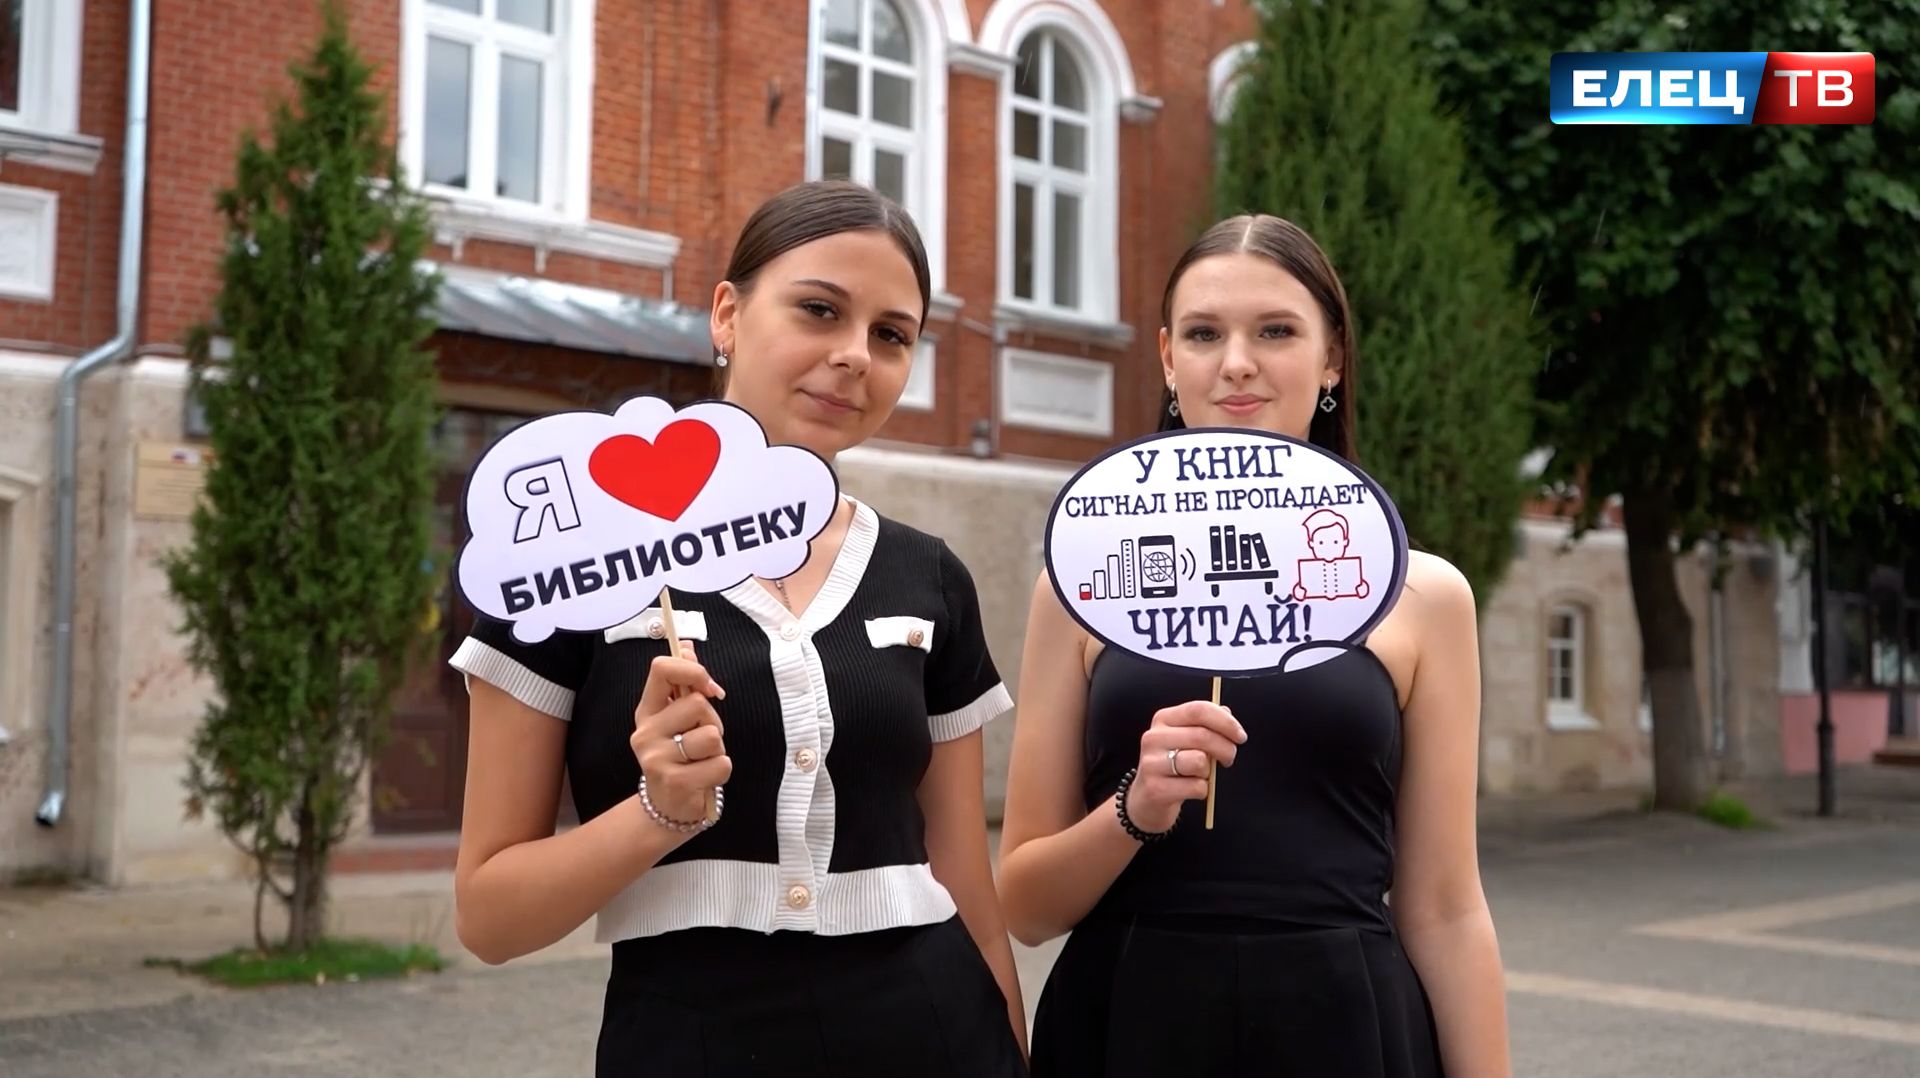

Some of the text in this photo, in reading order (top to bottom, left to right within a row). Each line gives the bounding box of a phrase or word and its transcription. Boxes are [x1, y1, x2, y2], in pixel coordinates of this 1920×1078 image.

[1132, 444, 1292, 484] У КНИГ
[503, 456, 581, 544] Я
[1065, 483, 1368, 518] СИГНАЛ НЕ ПРОПАДАЕТ
[500, 501, 807, 615] БИБЛИОТЕКУ
[1127, 593, 1313, 651] ЧИТАЙ!
